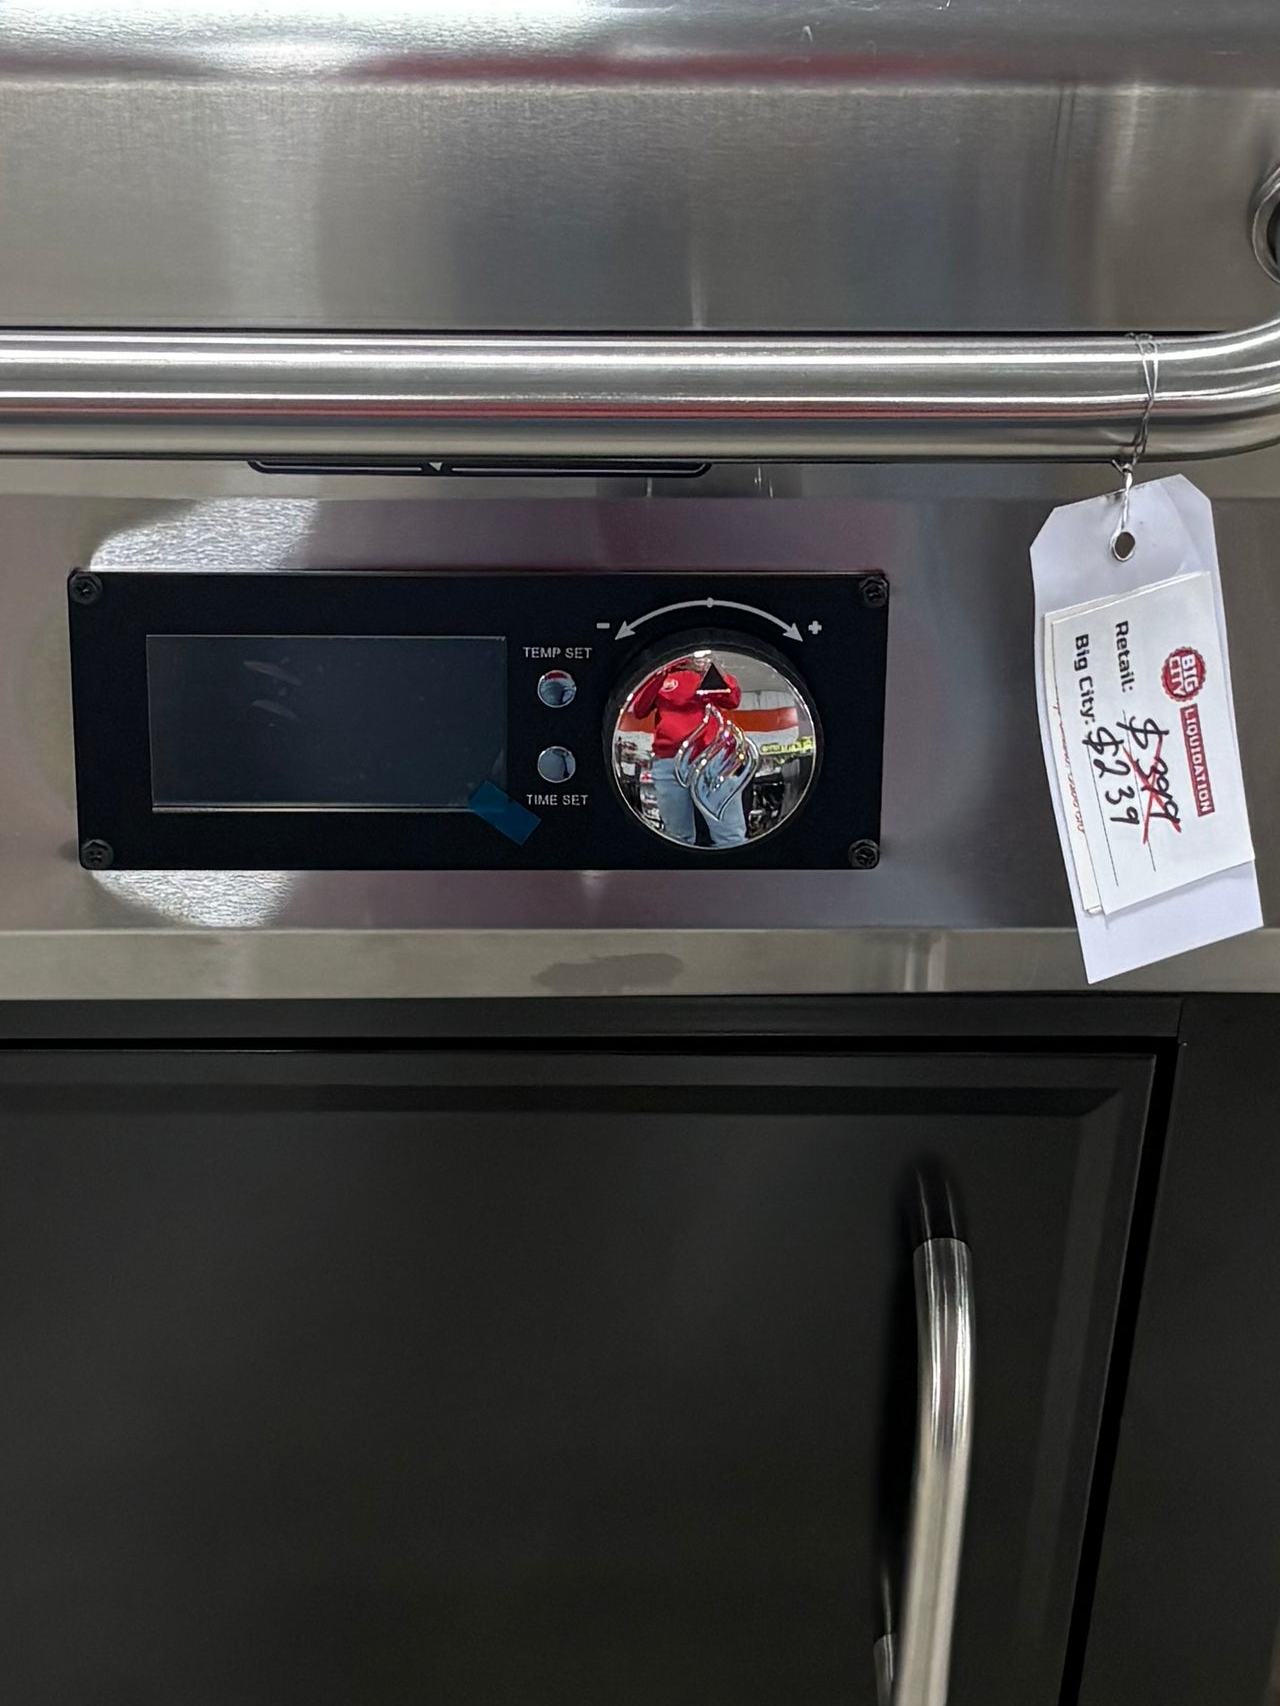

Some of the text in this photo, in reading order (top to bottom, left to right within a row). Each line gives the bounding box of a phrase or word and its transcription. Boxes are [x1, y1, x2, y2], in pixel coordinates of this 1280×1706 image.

[523, 647, 593, 660] TEMP SET
[1115, 620, 1135, 693] Retail:
[1180, 653, 1199, 692] BIG
[1169, 655, 1188, 697] CITY
[1074, 633, 1140, 825] Big City: $239
[1182, 706, 1214, 813] LIQUIDATION
[526, 794, 589, 806] TIME SET
